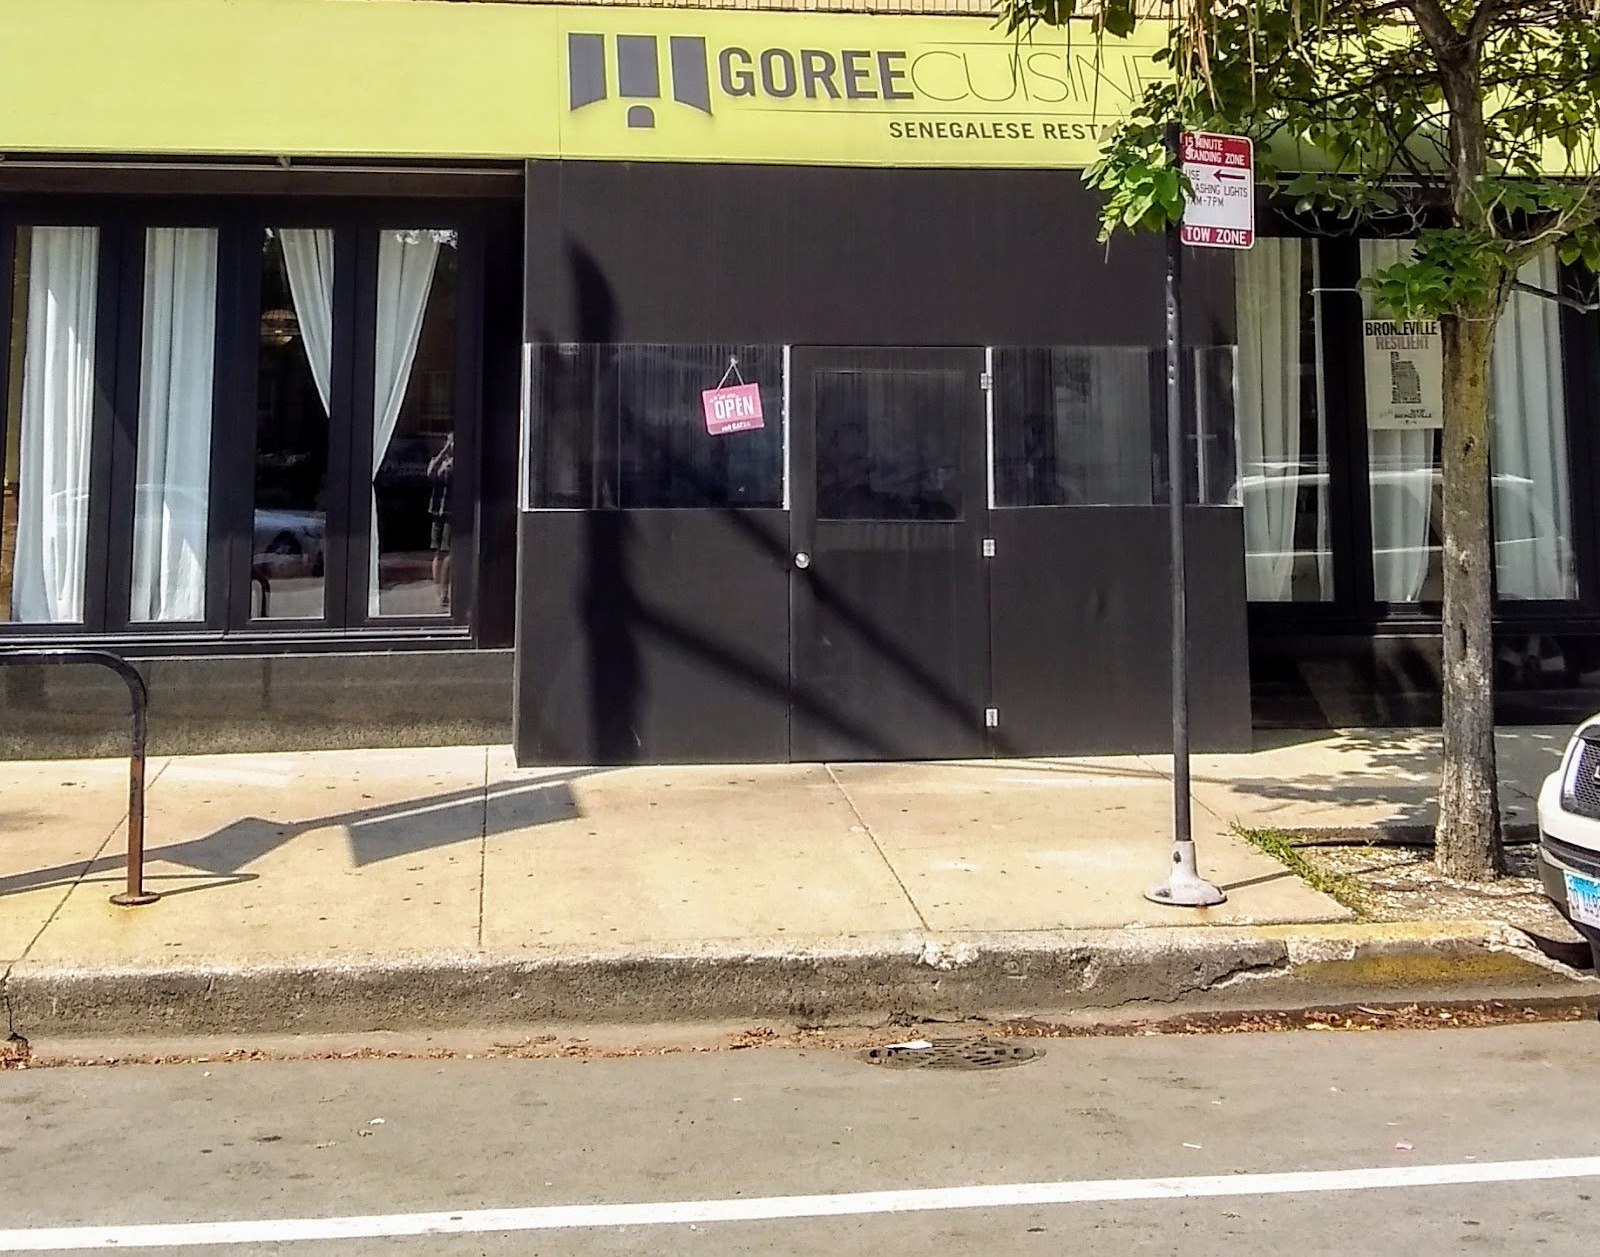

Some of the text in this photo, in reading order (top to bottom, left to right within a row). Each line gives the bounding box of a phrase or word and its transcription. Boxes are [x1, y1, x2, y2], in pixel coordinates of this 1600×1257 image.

[718, 46, 1172, 103] GOREE CUISINE
[889, 121, 1035, 140] SENEGALESE
[1185, 147, 1246, 166] STANDING ZONE
[1223, 186, 1248, 198] LIGHTS
[1186, 227, 1247, 245] TOW ZONE
[1375, 336, 1429, 350] RESILIENT
[714, 396, 755, 419] OPEN
